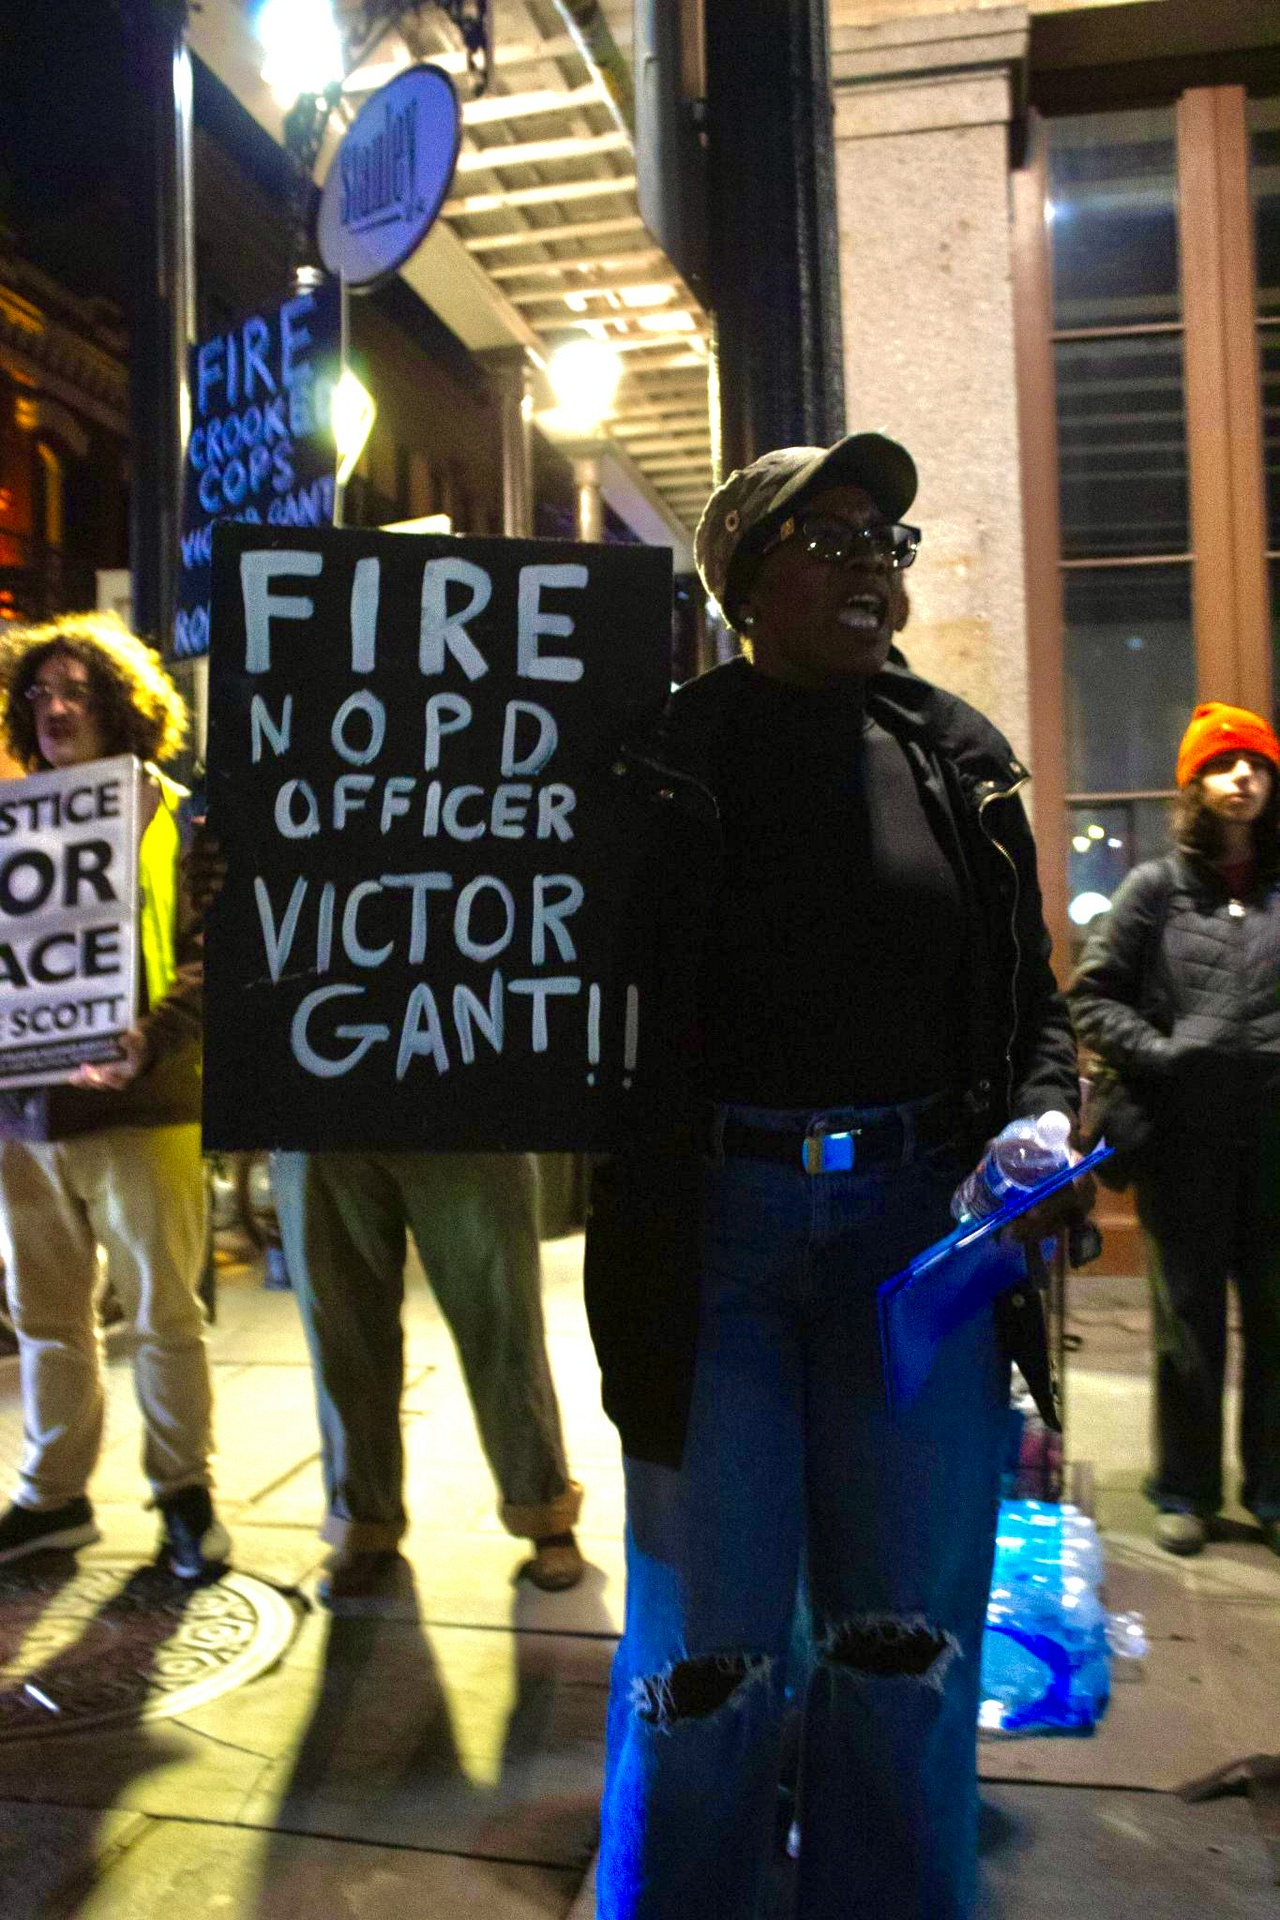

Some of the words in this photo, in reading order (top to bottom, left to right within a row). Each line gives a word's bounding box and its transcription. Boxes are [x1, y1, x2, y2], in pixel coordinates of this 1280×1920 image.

[197, 293, 316, 416] FIRE
[199, 439, 296, 513] COPS
[240, 550, 589, 682] FIRE
[250, 689, 559, 778] NOPD
[0, 781, 120, 836] STICE
[274, 773, 577, 842] OFFICER
[0, 839, 119, 917] OR
[254, 872, 585, 986] VICTOR
[10, 994, 124, 1038] SCOTT
[290, 968, 639, 1091] GANT!!
